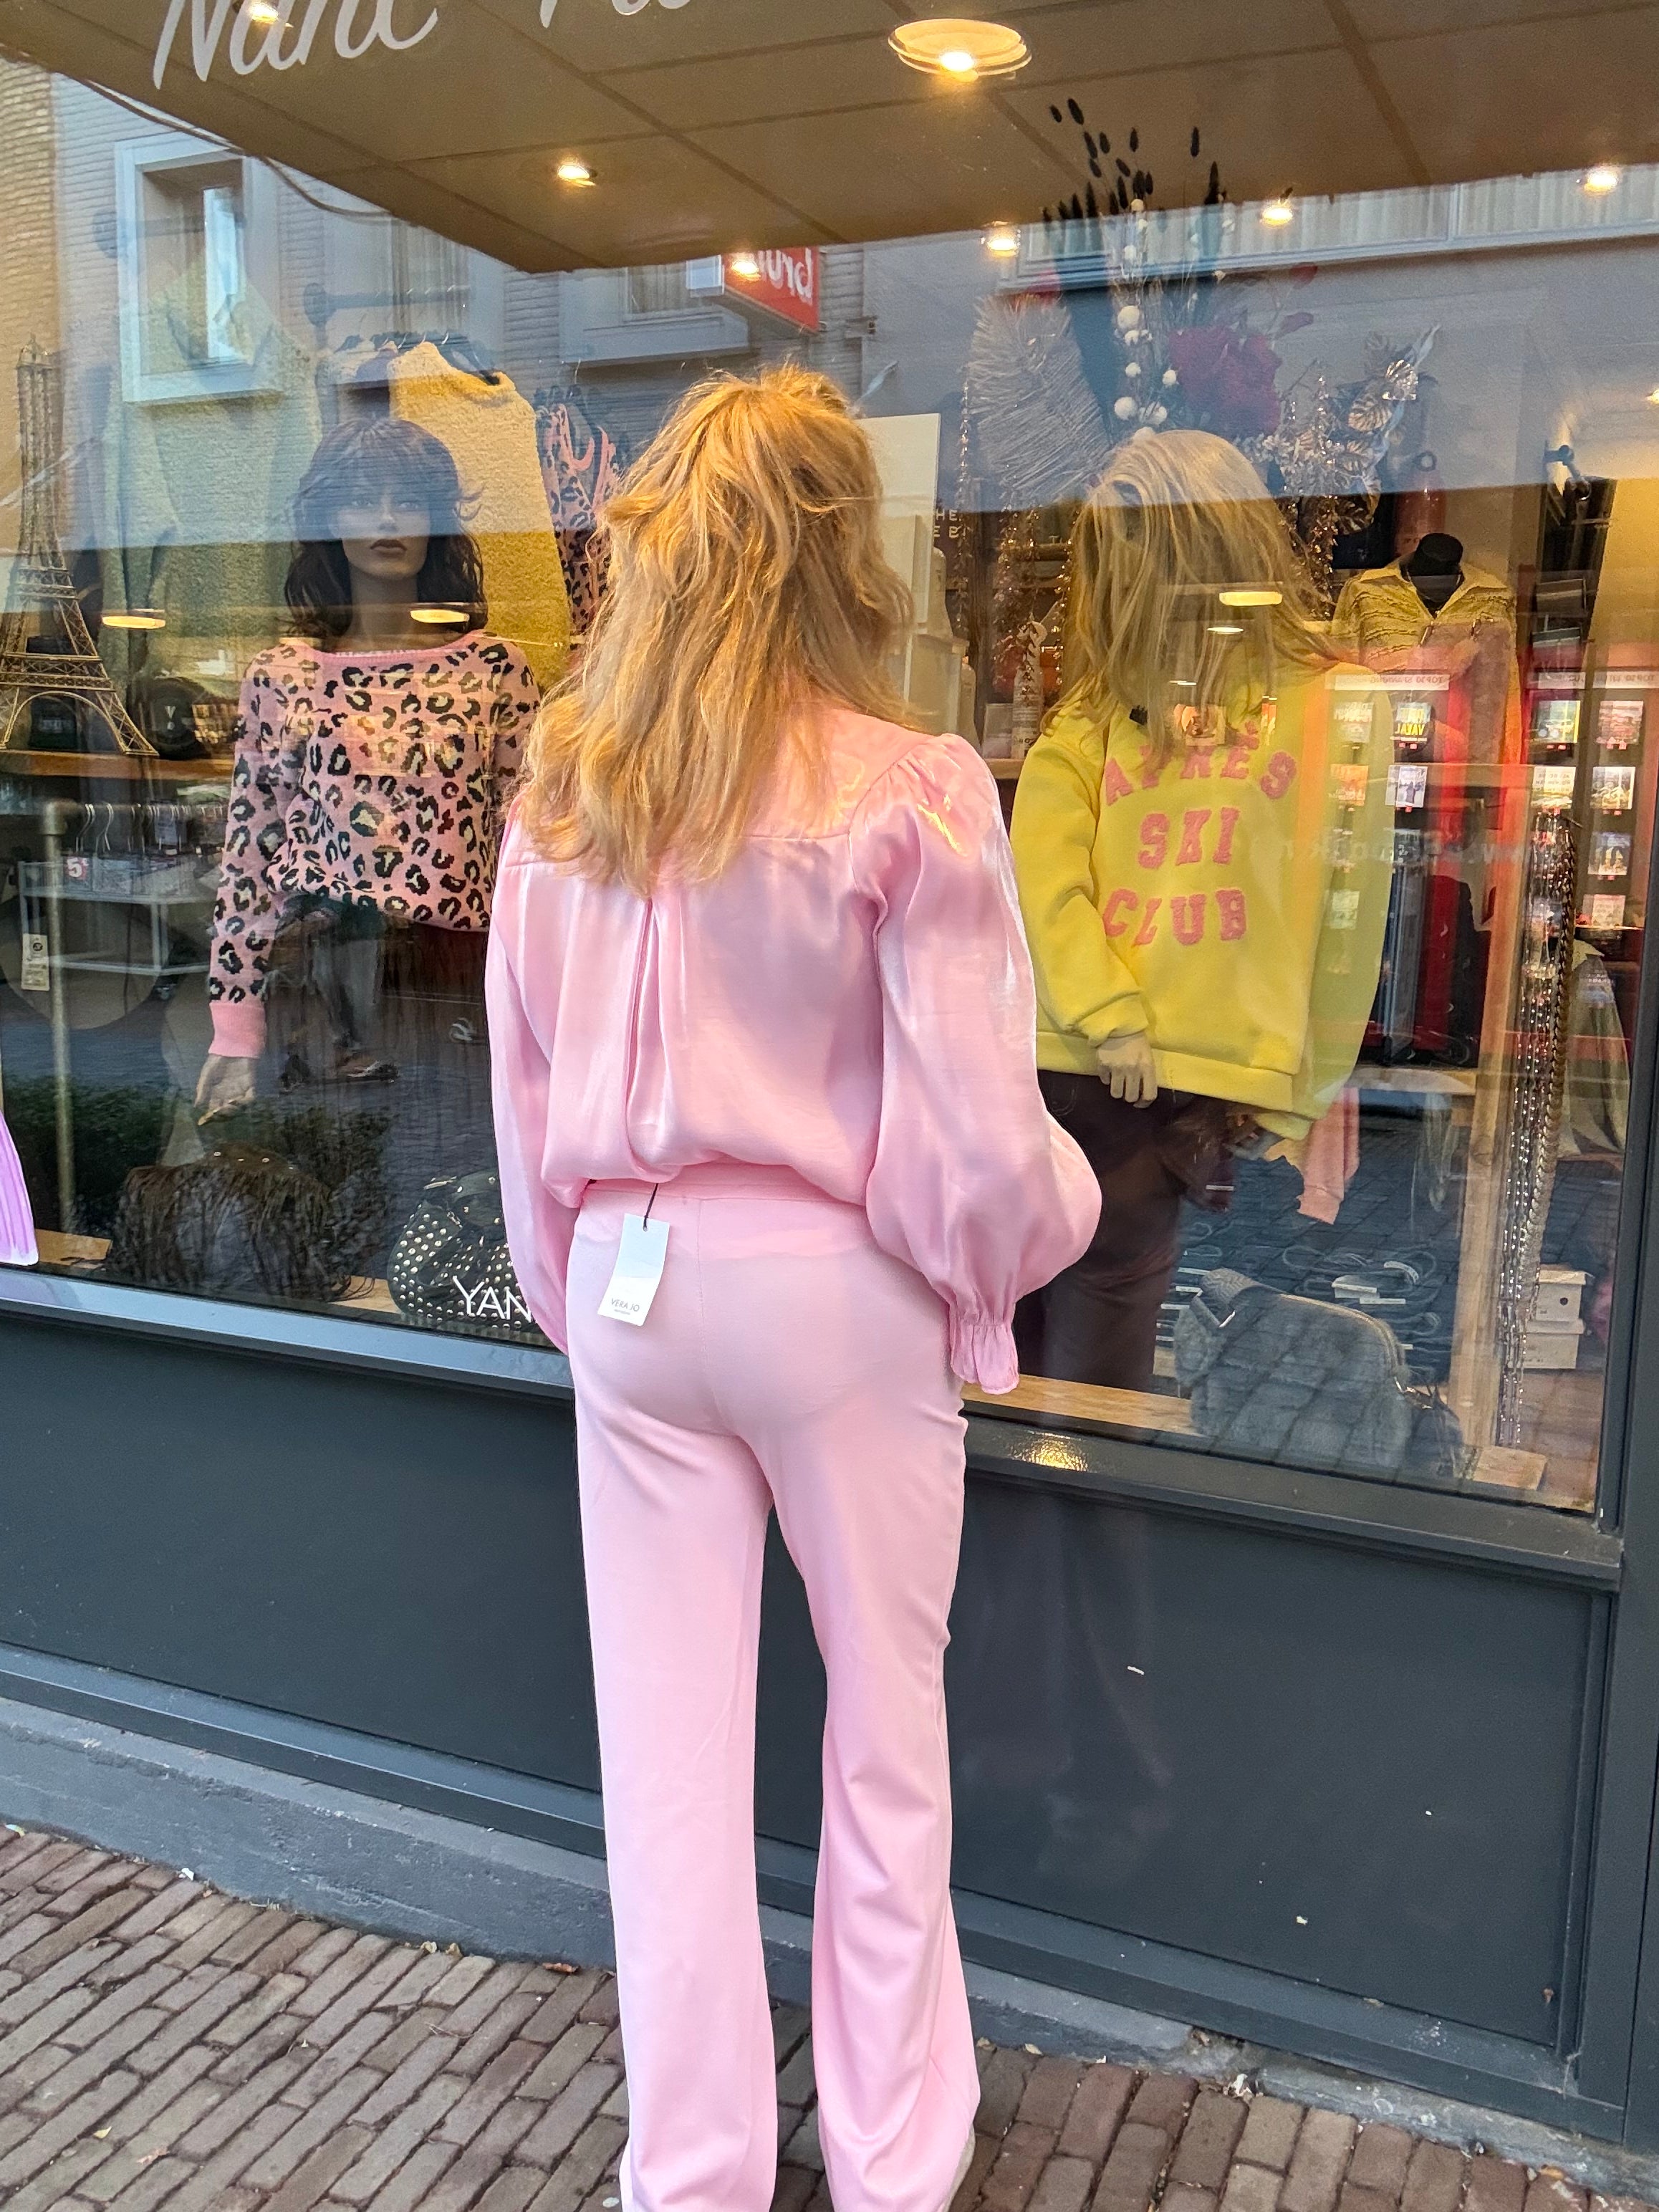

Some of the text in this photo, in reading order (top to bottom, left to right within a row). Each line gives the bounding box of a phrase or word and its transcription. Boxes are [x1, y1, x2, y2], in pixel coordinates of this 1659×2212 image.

[1138, 807, 1240, 870] SKI
[1102, 888, 1248, 946] CLUB
[611, 1298, 628, 1309] VERA
[630, 1304, 640, 1312] JO
